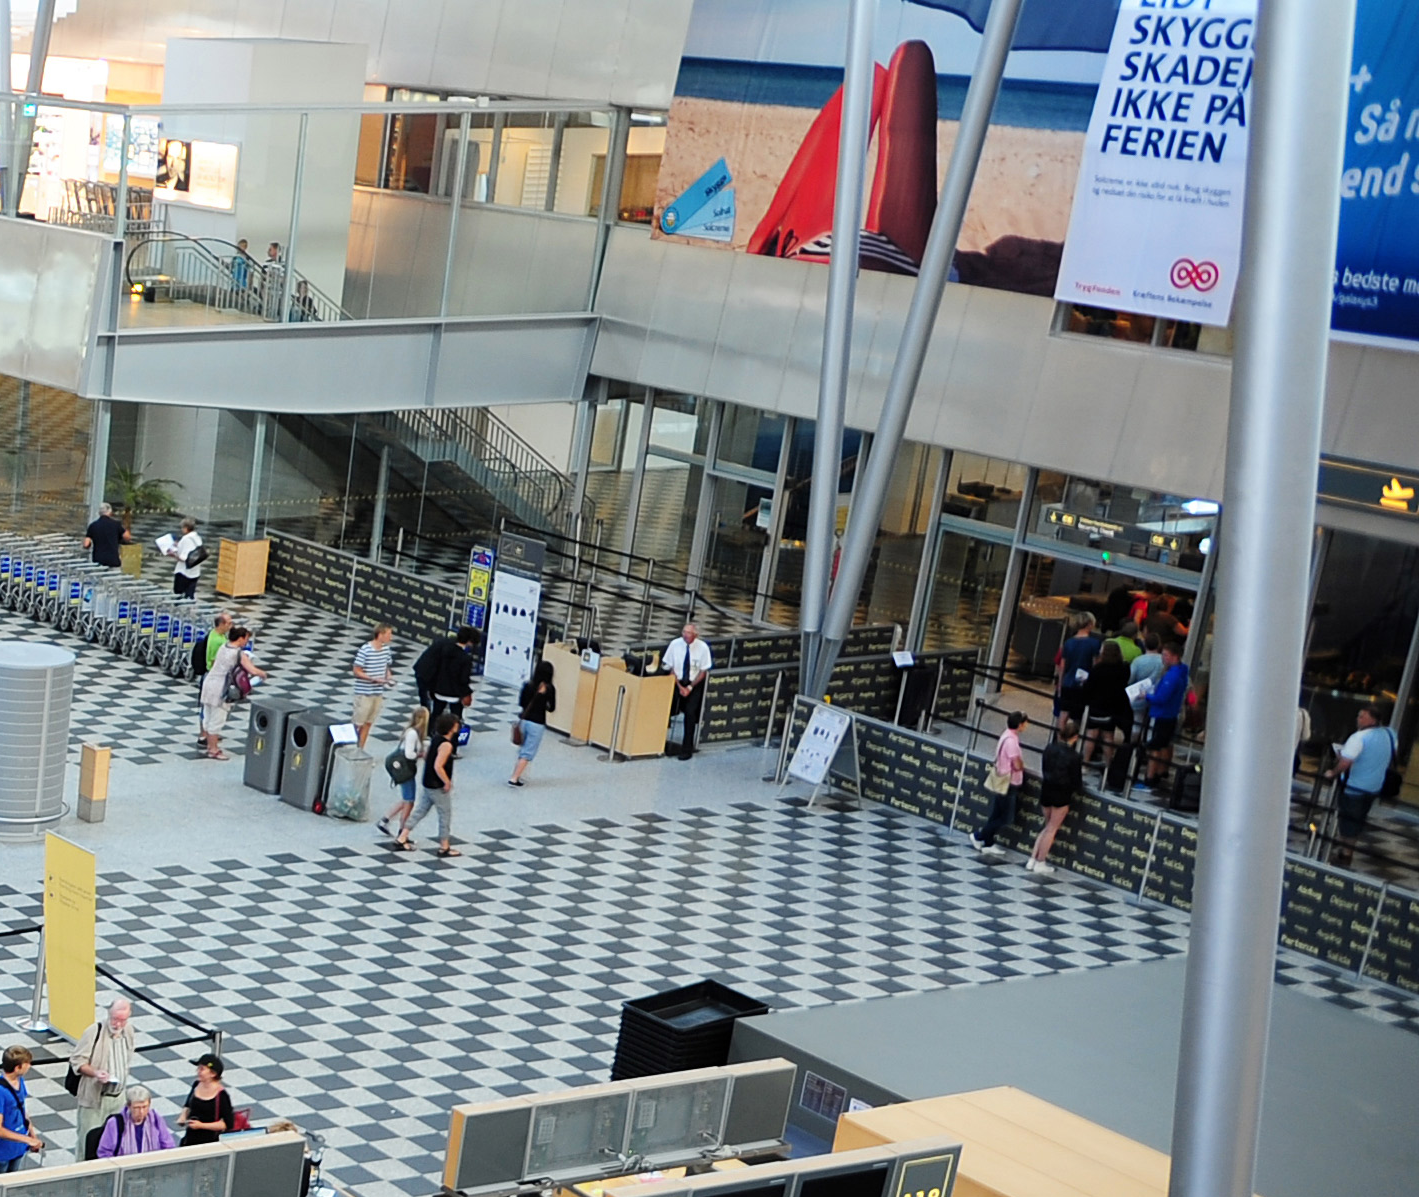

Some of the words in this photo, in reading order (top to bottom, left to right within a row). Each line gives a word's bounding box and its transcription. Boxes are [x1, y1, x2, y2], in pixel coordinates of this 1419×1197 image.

[1129, 14, 1253, 50] SKYGG
[1110, 88, 1194, 123] IKKE
[1203, 86, 1247, 127] PÅ
[1354, 98, 1402, 145] Så
[1100, 124, 1227, 163] FERIEN
[1342, 266, 1399, 292] bedste
